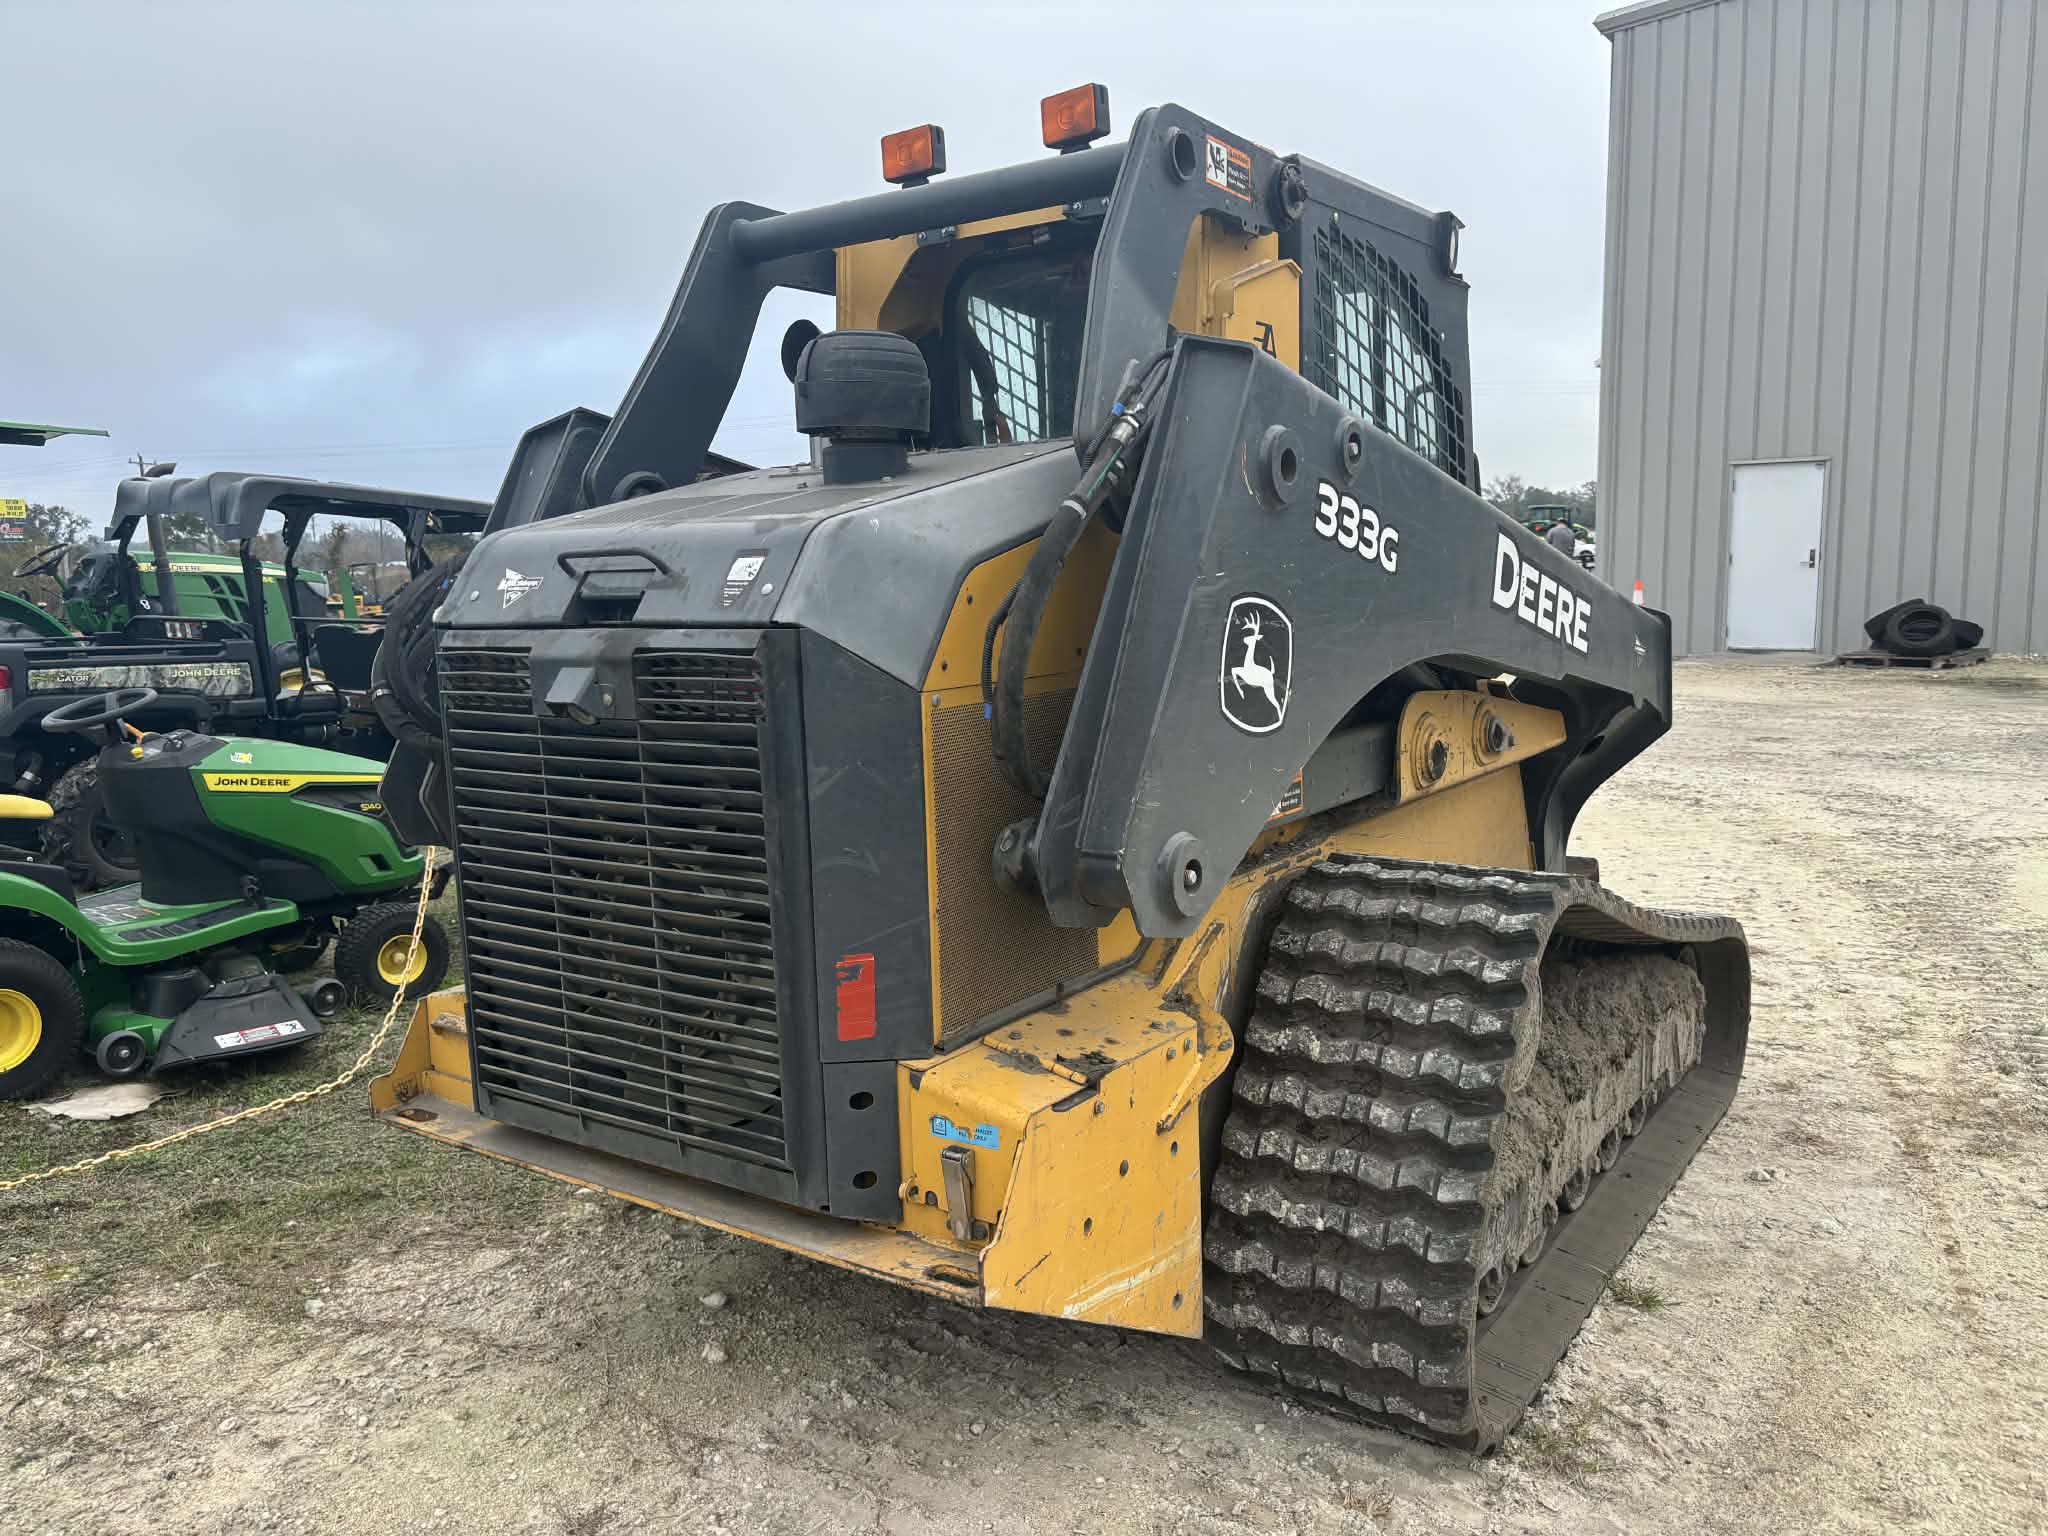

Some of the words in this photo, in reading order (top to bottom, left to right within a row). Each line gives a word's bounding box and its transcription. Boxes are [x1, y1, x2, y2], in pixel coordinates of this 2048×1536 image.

[1315, 482, 1399, 572] 333G
[1493, 532, 1591, 653] DEERE
[57, 674, 89, 682] GATOR
[171, 669, 202, 678] JOHN
[204, 668, 241, 677] DEERE
[214, 777, 248, 786] JOHN
[250, 777, 291, 787] DEERE
